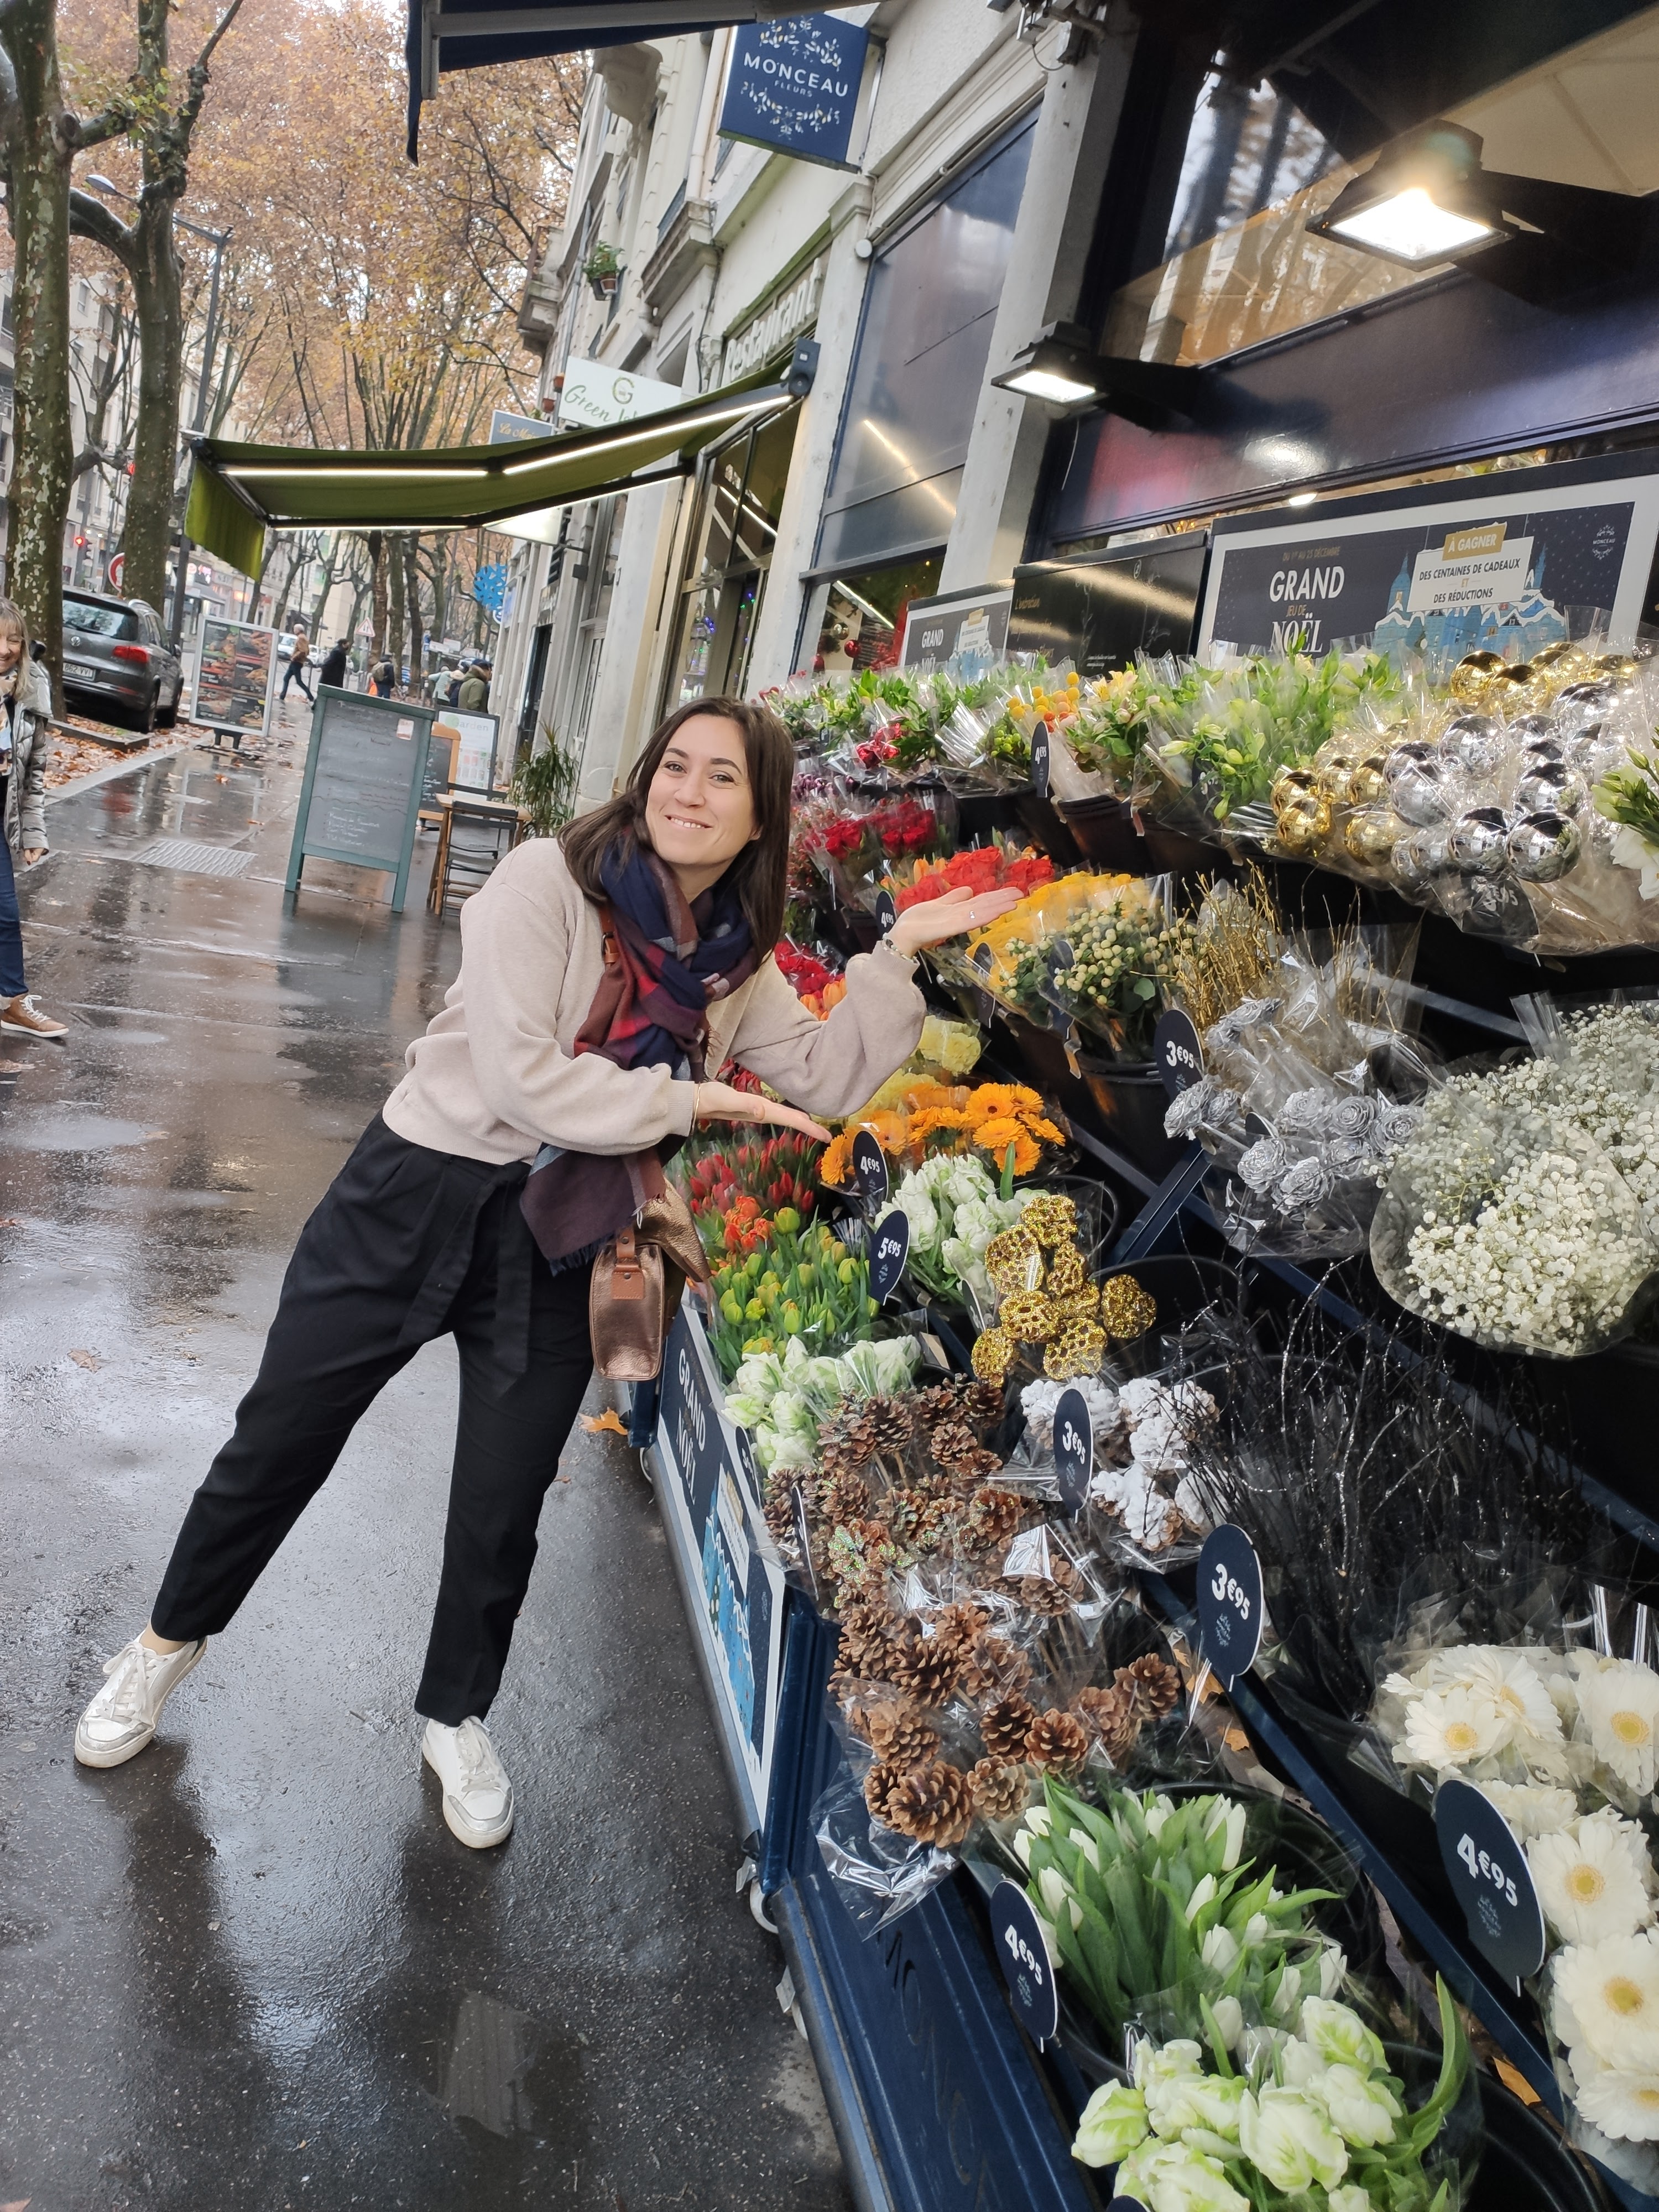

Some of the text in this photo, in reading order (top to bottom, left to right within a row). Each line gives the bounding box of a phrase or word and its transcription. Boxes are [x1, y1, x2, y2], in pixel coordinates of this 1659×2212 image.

[744, 53, 848, 97] MONCEAU
[774, 80, 812, 97] FLEURS
[722, 257, 821, 387] Restaurant
[564, 385, 609, 422] Green
[1448, 533, 1497, 552] À GAGNER
[1270, 566, 1344, 602] GRAND
[1419, 558, 1521, 581] DES CENTAINES DE CADEAUX
[1297, 604, 1307, 616] DE
[1433, 587, 1494, 603] DES RÉDUCTIONS
[921, 628, 944, 648] GRAND
[1269, 612, 1323, 654] NOËL
[1035, 746, 1047, 764] 4€95
[1166, 1040, 1194, 1068] 3€95
[860, 1156, 880, 1175] 4€95
[878, 1237, 901, 1259] 5€95
[679, 1348, 706, 1452] GRAND
[676, 1407, 696, 1505] NOËL
[1062, 1421, 1086, 1464] 3€95
[1212, 1563, 1250, 1620] 3€95
[1457, 1833, 1518, 1907] 4€95
[1005, 1924, 1042, 1985] 4€95
